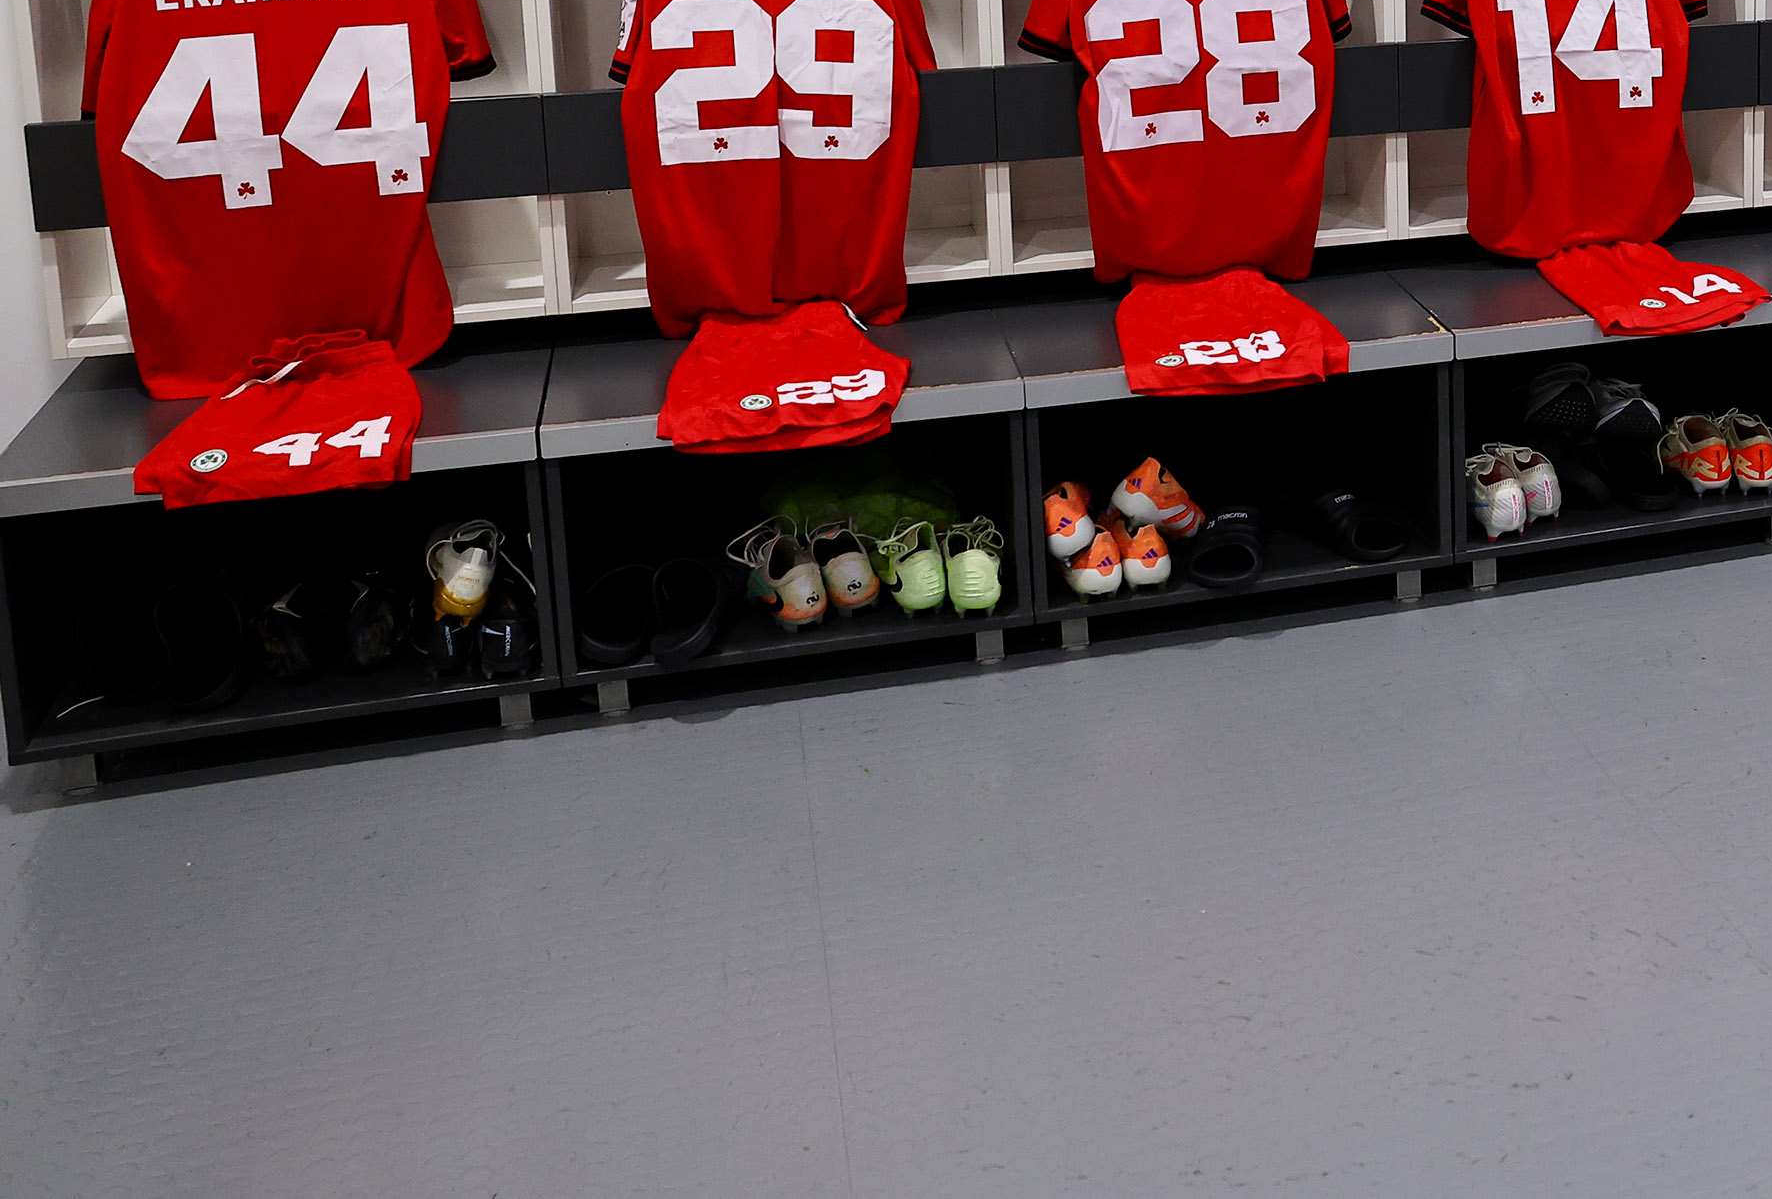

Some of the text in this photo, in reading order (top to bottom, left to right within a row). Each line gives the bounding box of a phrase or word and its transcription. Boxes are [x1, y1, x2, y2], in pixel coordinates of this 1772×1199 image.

[121, 23, 430, 209] 44
[1659, 273, 1742, 305] 14
[1180, 330, 1286, 365] 28
[777, 369, 885, 405] 29
[253, 416, 391, 466] 44
[1218, 511, 1248, 522] macron
